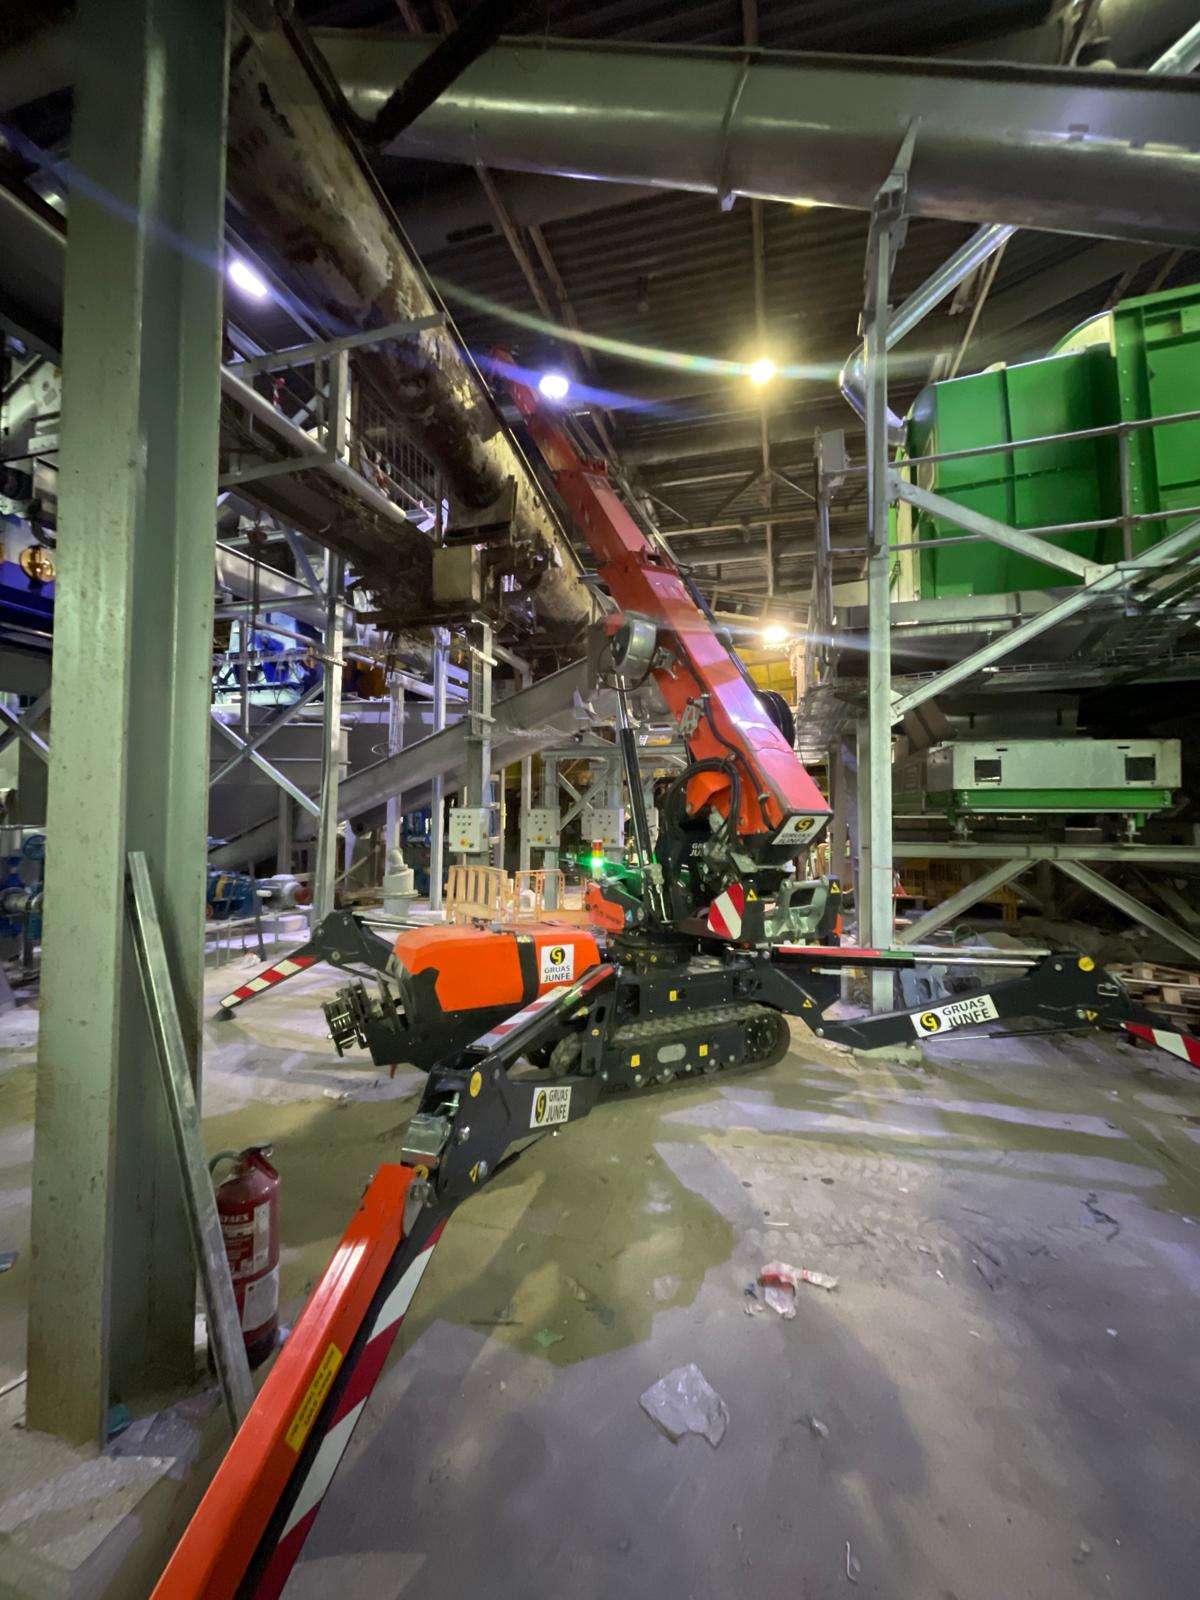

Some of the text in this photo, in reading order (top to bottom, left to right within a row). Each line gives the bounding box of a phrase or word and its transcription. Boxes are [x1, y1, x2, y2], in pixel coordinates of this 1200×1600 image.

[544, 972, 570, 982] JUNFE
[942, 998, 985, 1015] GRUAS
[949, 1008, 990, 1027] JUNFE
[549, 1089, 568, 1102] GRUAS
[546, 1104, 566, 1122] JUNFE
